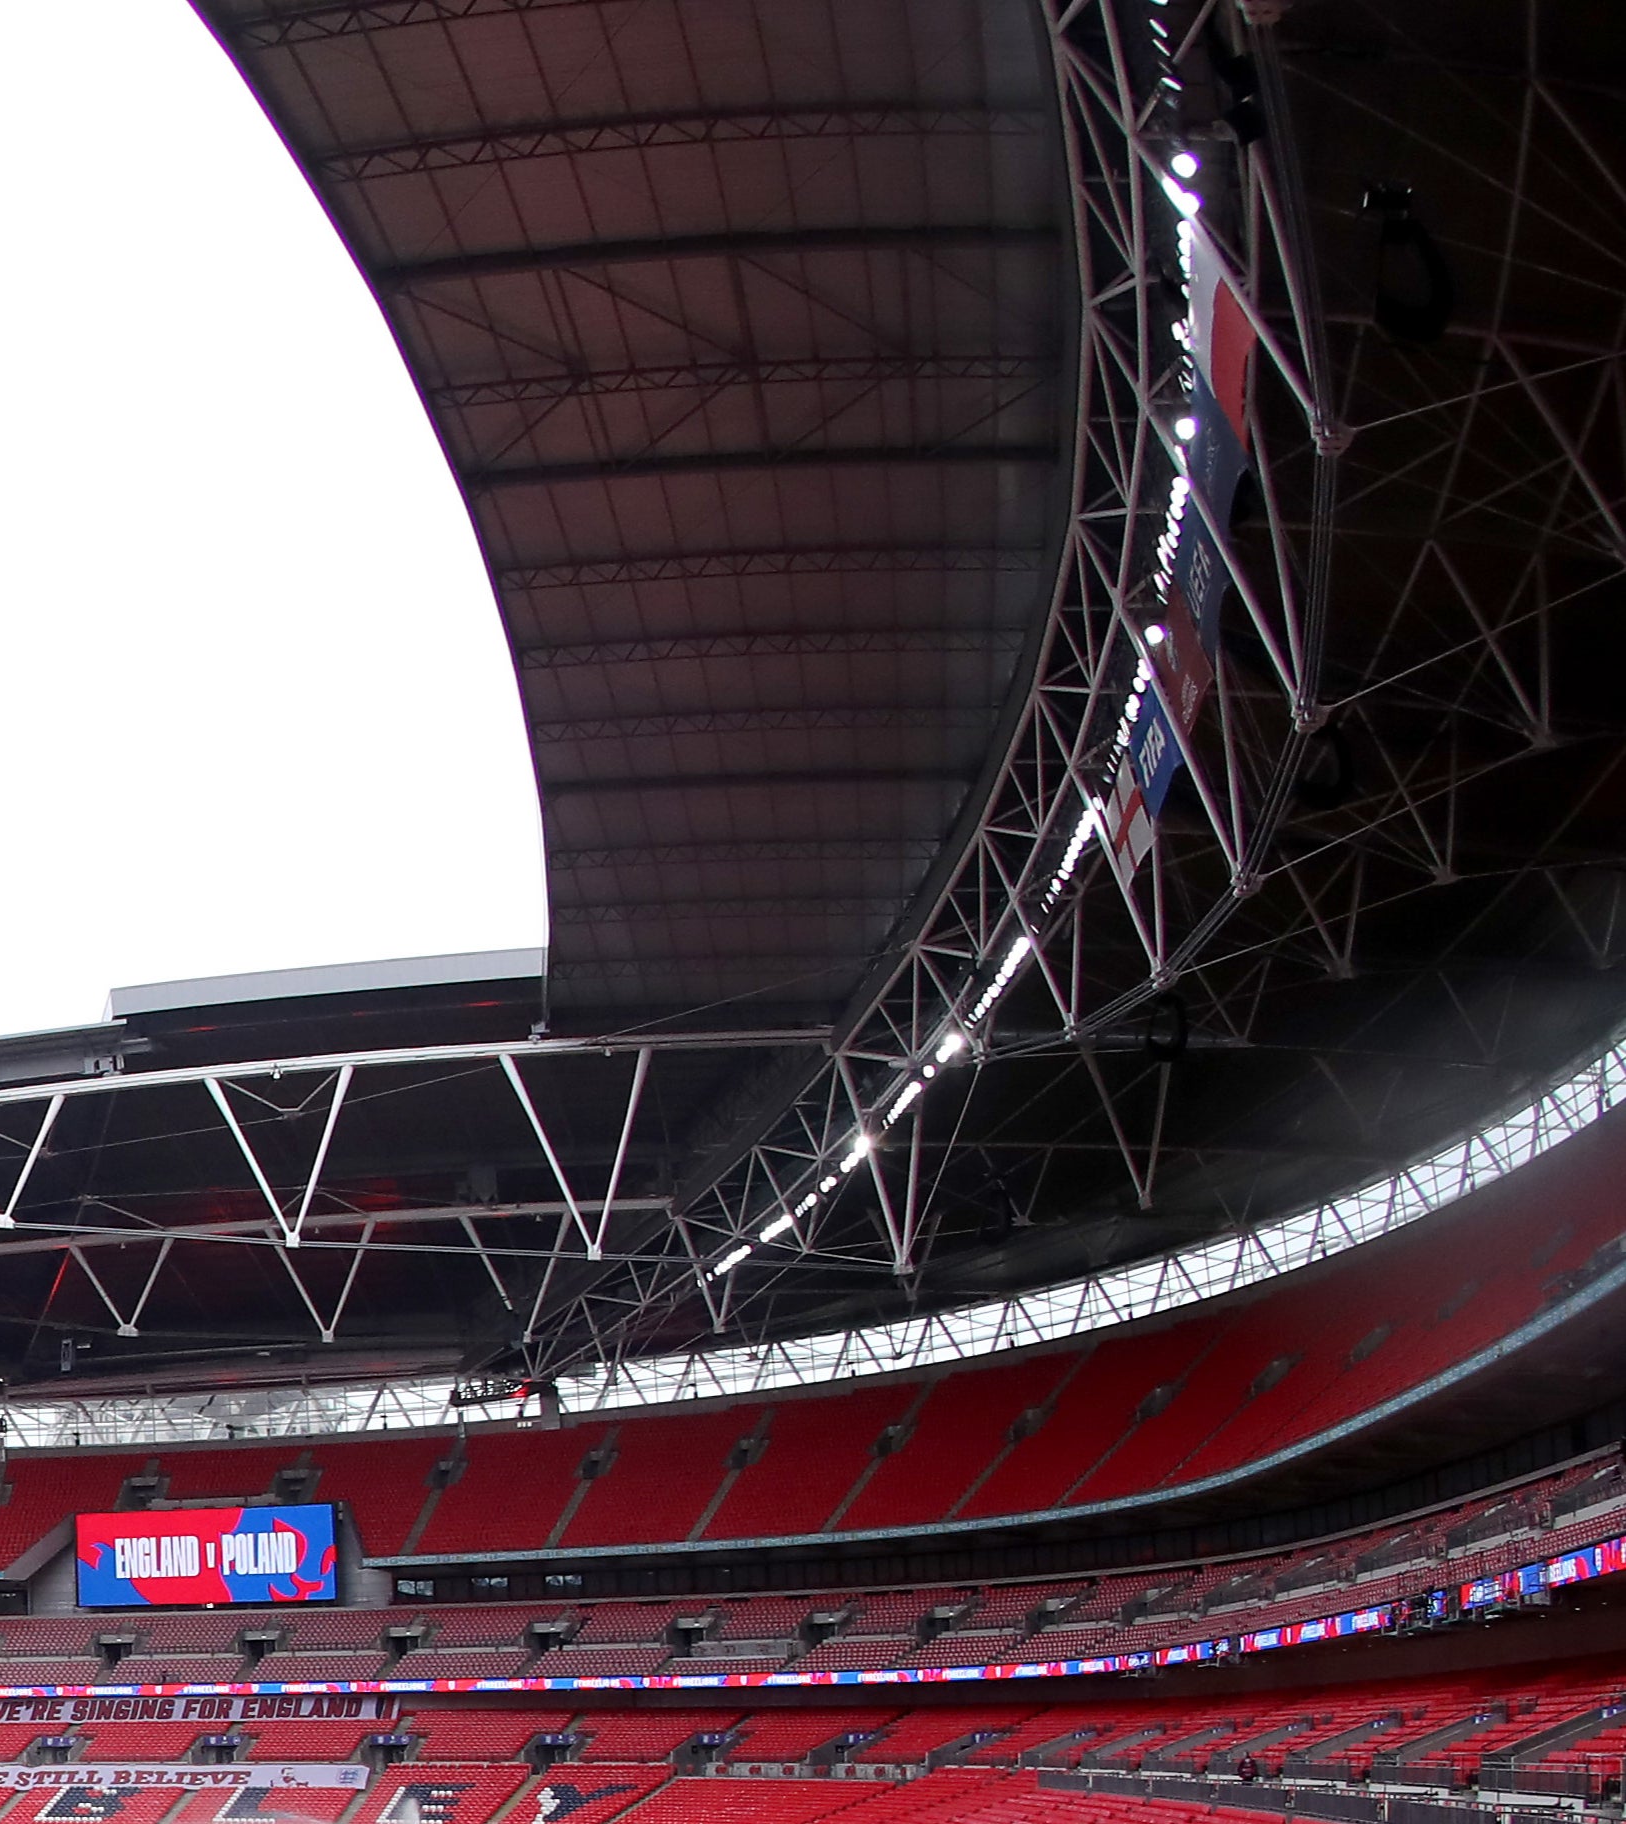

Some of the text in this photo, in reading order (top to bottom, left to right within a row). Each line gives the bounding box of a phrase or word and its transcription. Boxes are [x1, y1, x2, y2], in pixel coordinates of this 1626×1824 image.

[1187, 540, 1212, 620] UEFA
[1139, 718, 1167, 791] FIFA
[115, 1535, 200, 1579] ENGLAND
[221, 1532, 298, 1576] POLAND
[71, 1698, 175, 1721] SINGING
[181, 1698, 235, 1721] FOR
[241, 1696, 362, 1719] ENGLAND
[14, 1769, 103, 1788] STILL
[110, 1769, 252, 1787] BELIEVE
